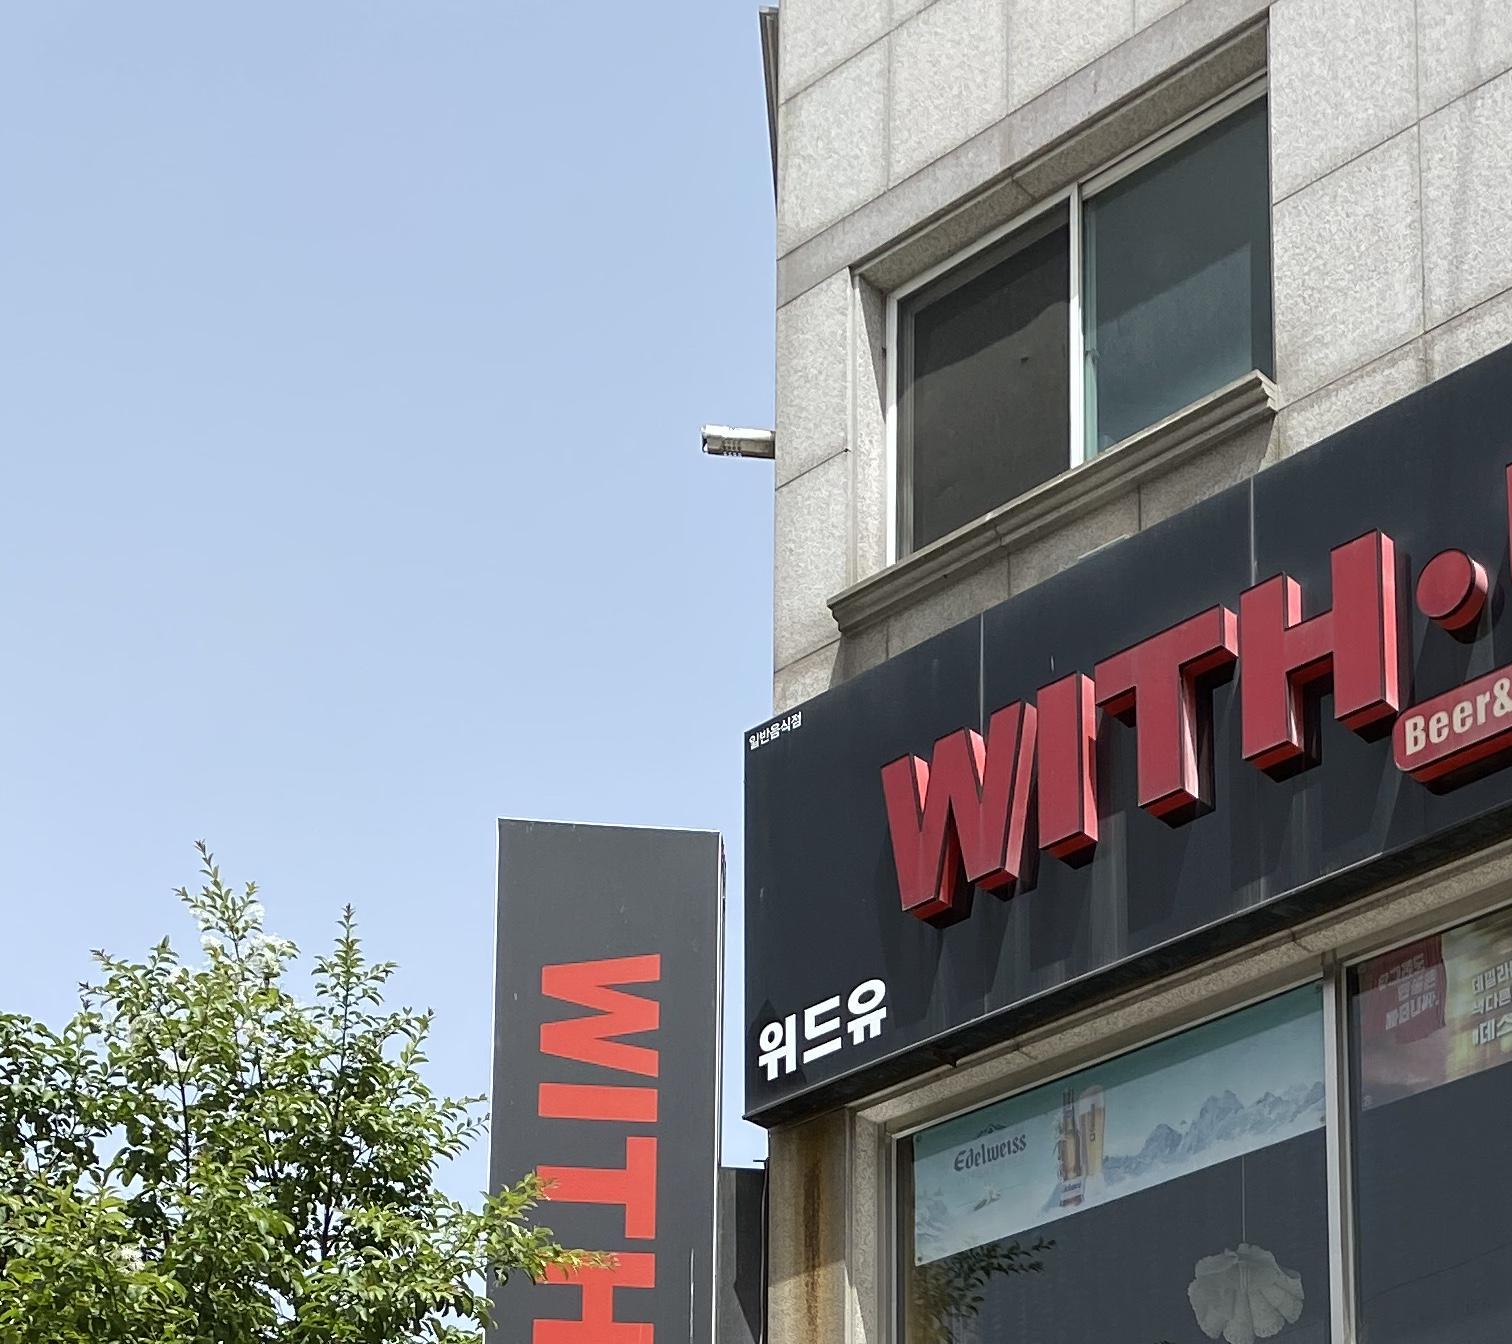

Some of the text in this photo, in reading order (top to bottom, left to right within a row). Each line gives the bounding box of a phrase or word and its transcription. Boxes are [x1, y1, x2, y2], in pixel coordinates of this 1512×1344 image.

[748, 711, 802, 750] 일반음식점
[757, 978, 888, 1080] 위드유
[953, 1132, 1028, 1172] Edelweiss
